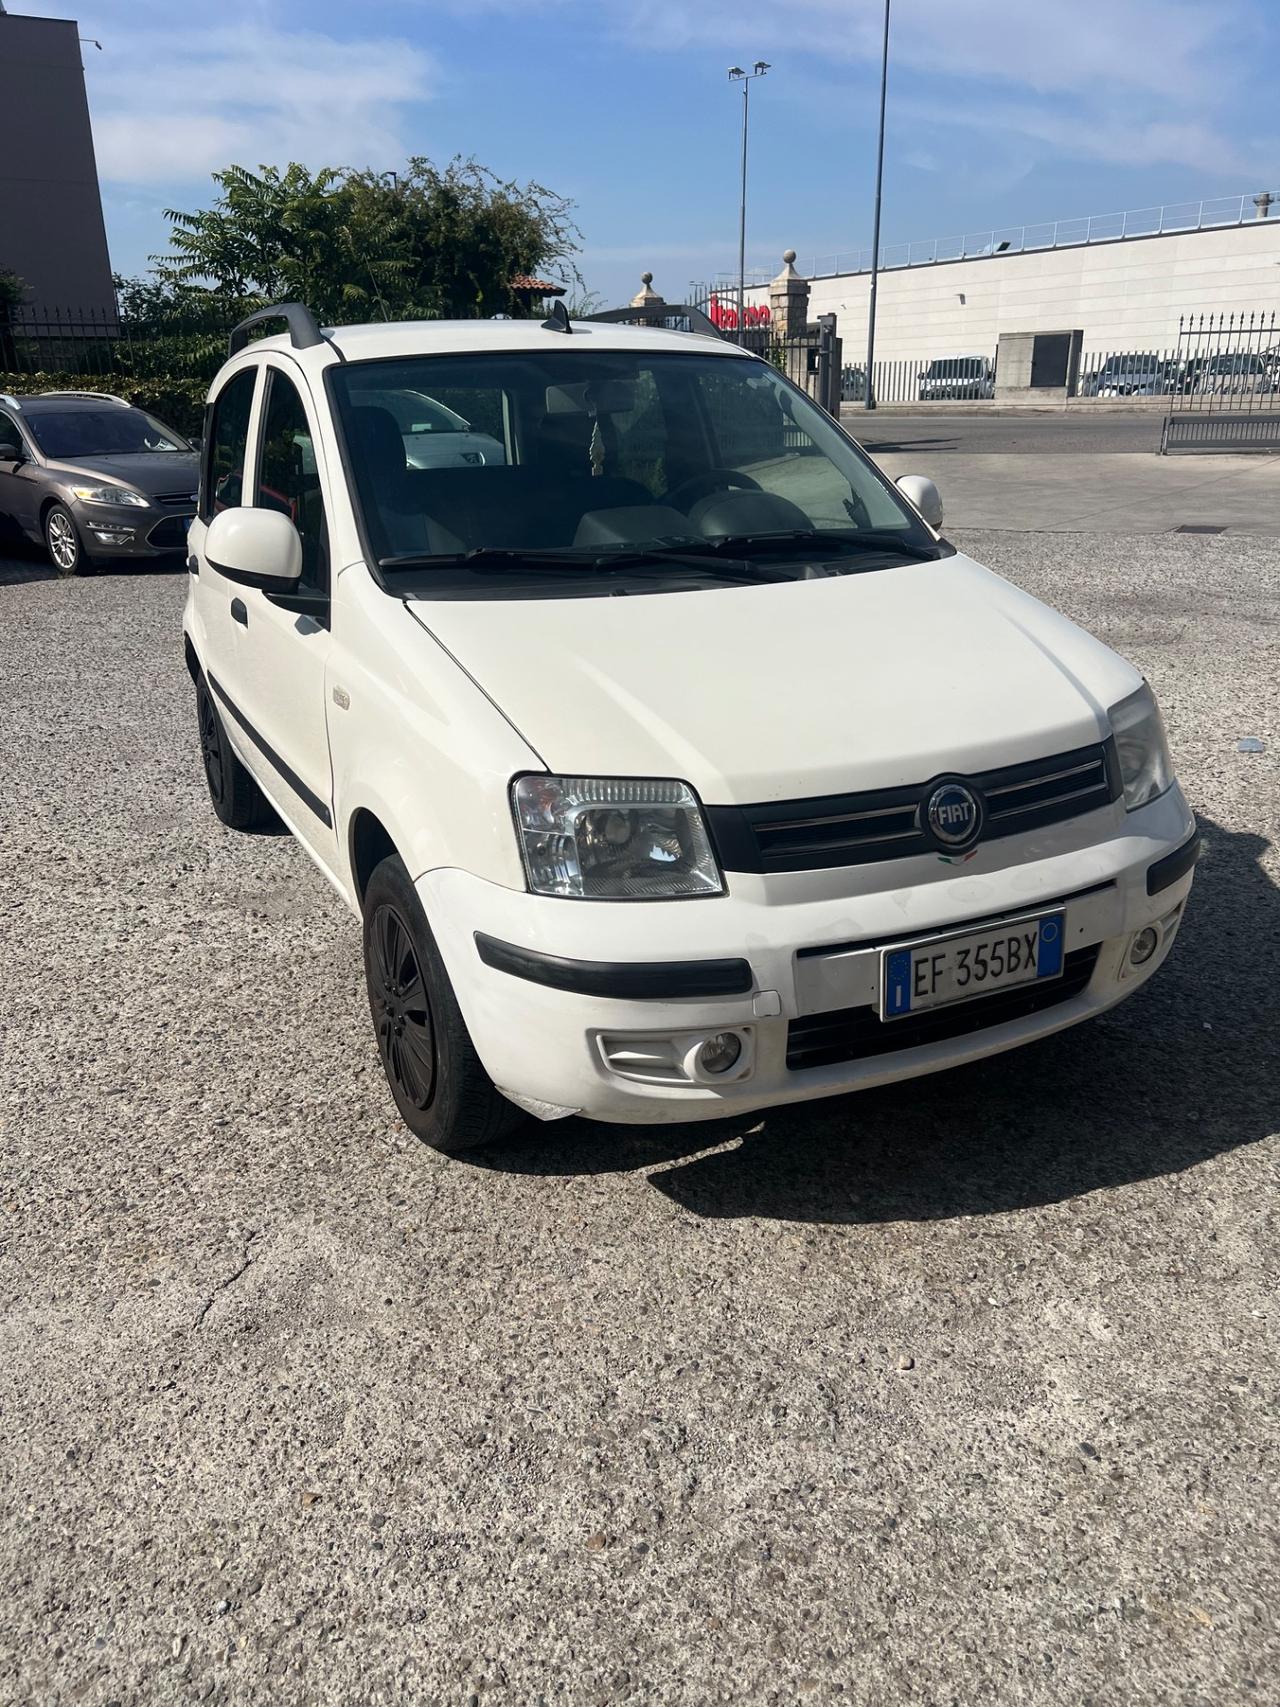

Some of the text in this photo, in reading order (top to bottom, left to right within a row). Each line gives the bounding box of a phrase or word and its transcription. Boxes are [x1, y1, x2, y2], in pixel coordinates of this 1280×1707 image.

[938, 802, 969, 825] FIAT
[914, 931, 1038, 997] EF 355BX
